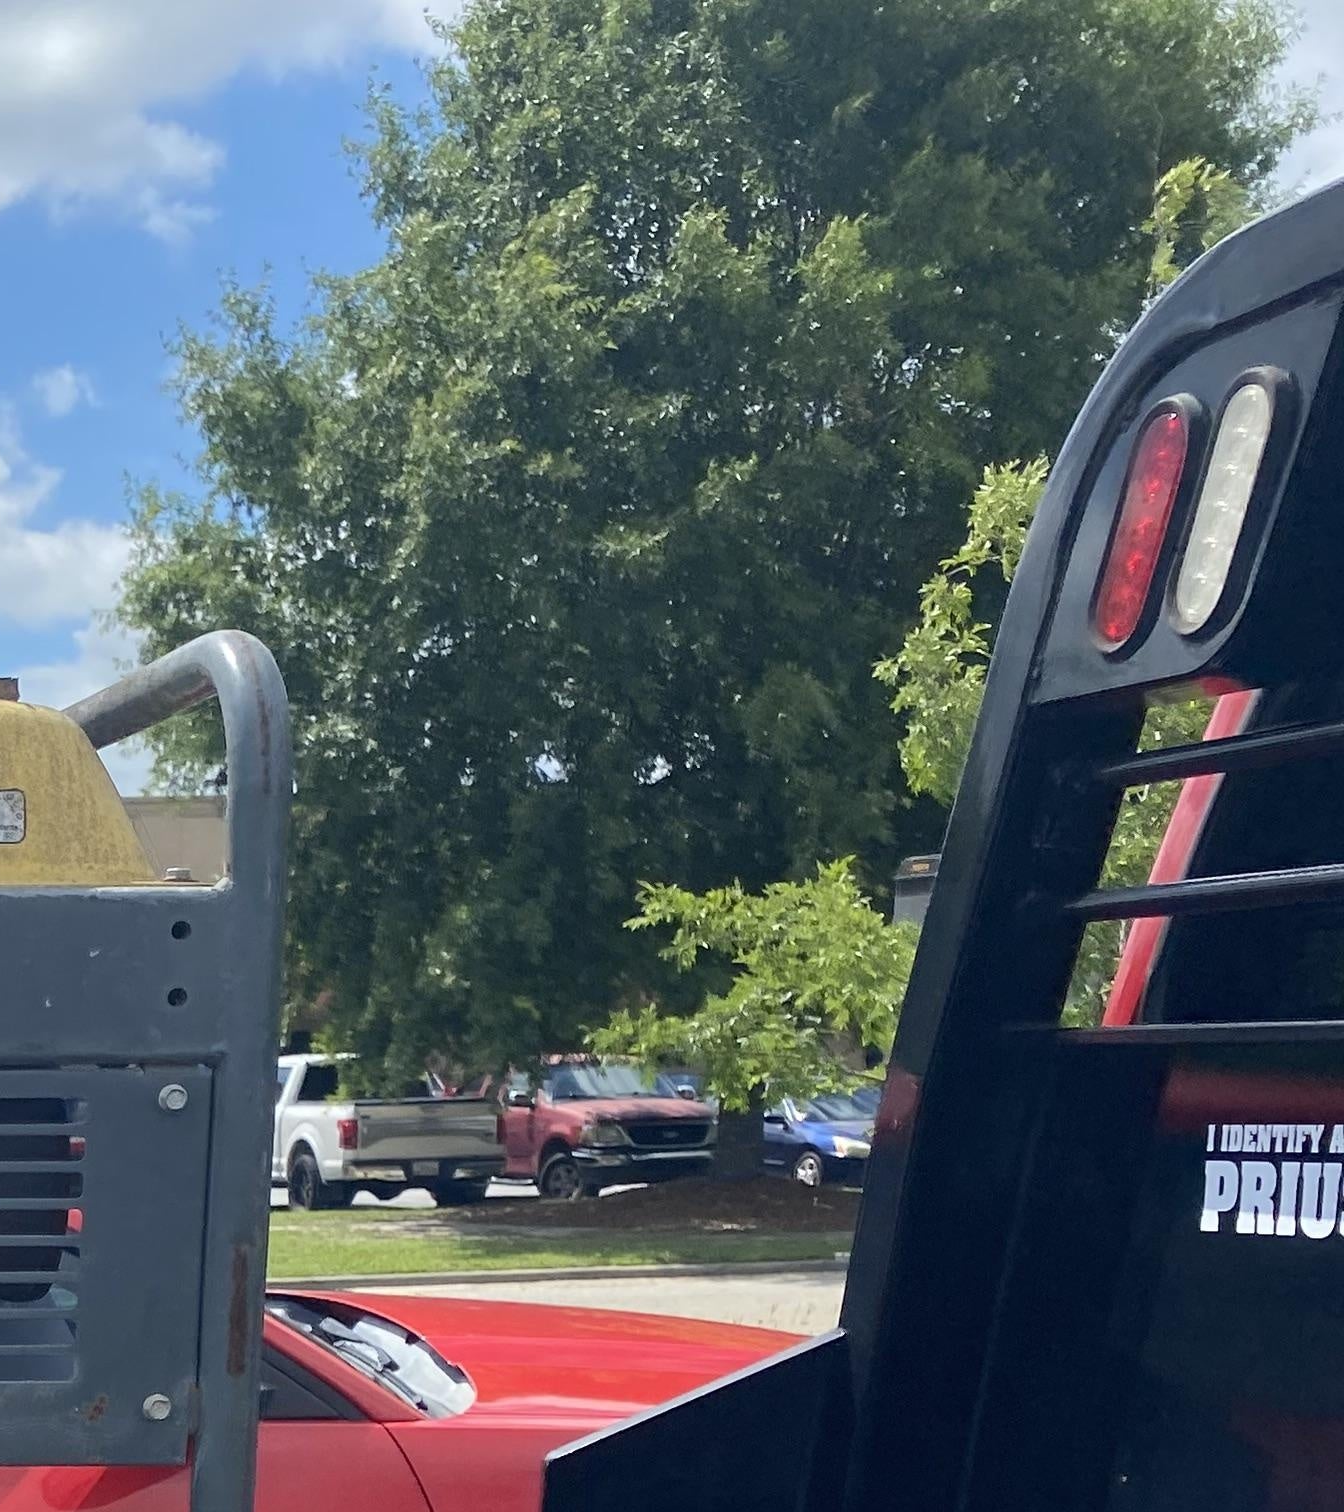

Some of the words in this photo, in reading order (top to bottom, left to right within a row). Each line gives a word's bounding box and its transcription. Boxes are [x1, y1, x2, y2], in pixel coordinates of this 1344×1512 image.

[1206, 1124, 1217, 1152] I
[1220, 1124, 1325, 1153] IDENTIFY
[1200, 1160, 1344, 1240] PRIU
